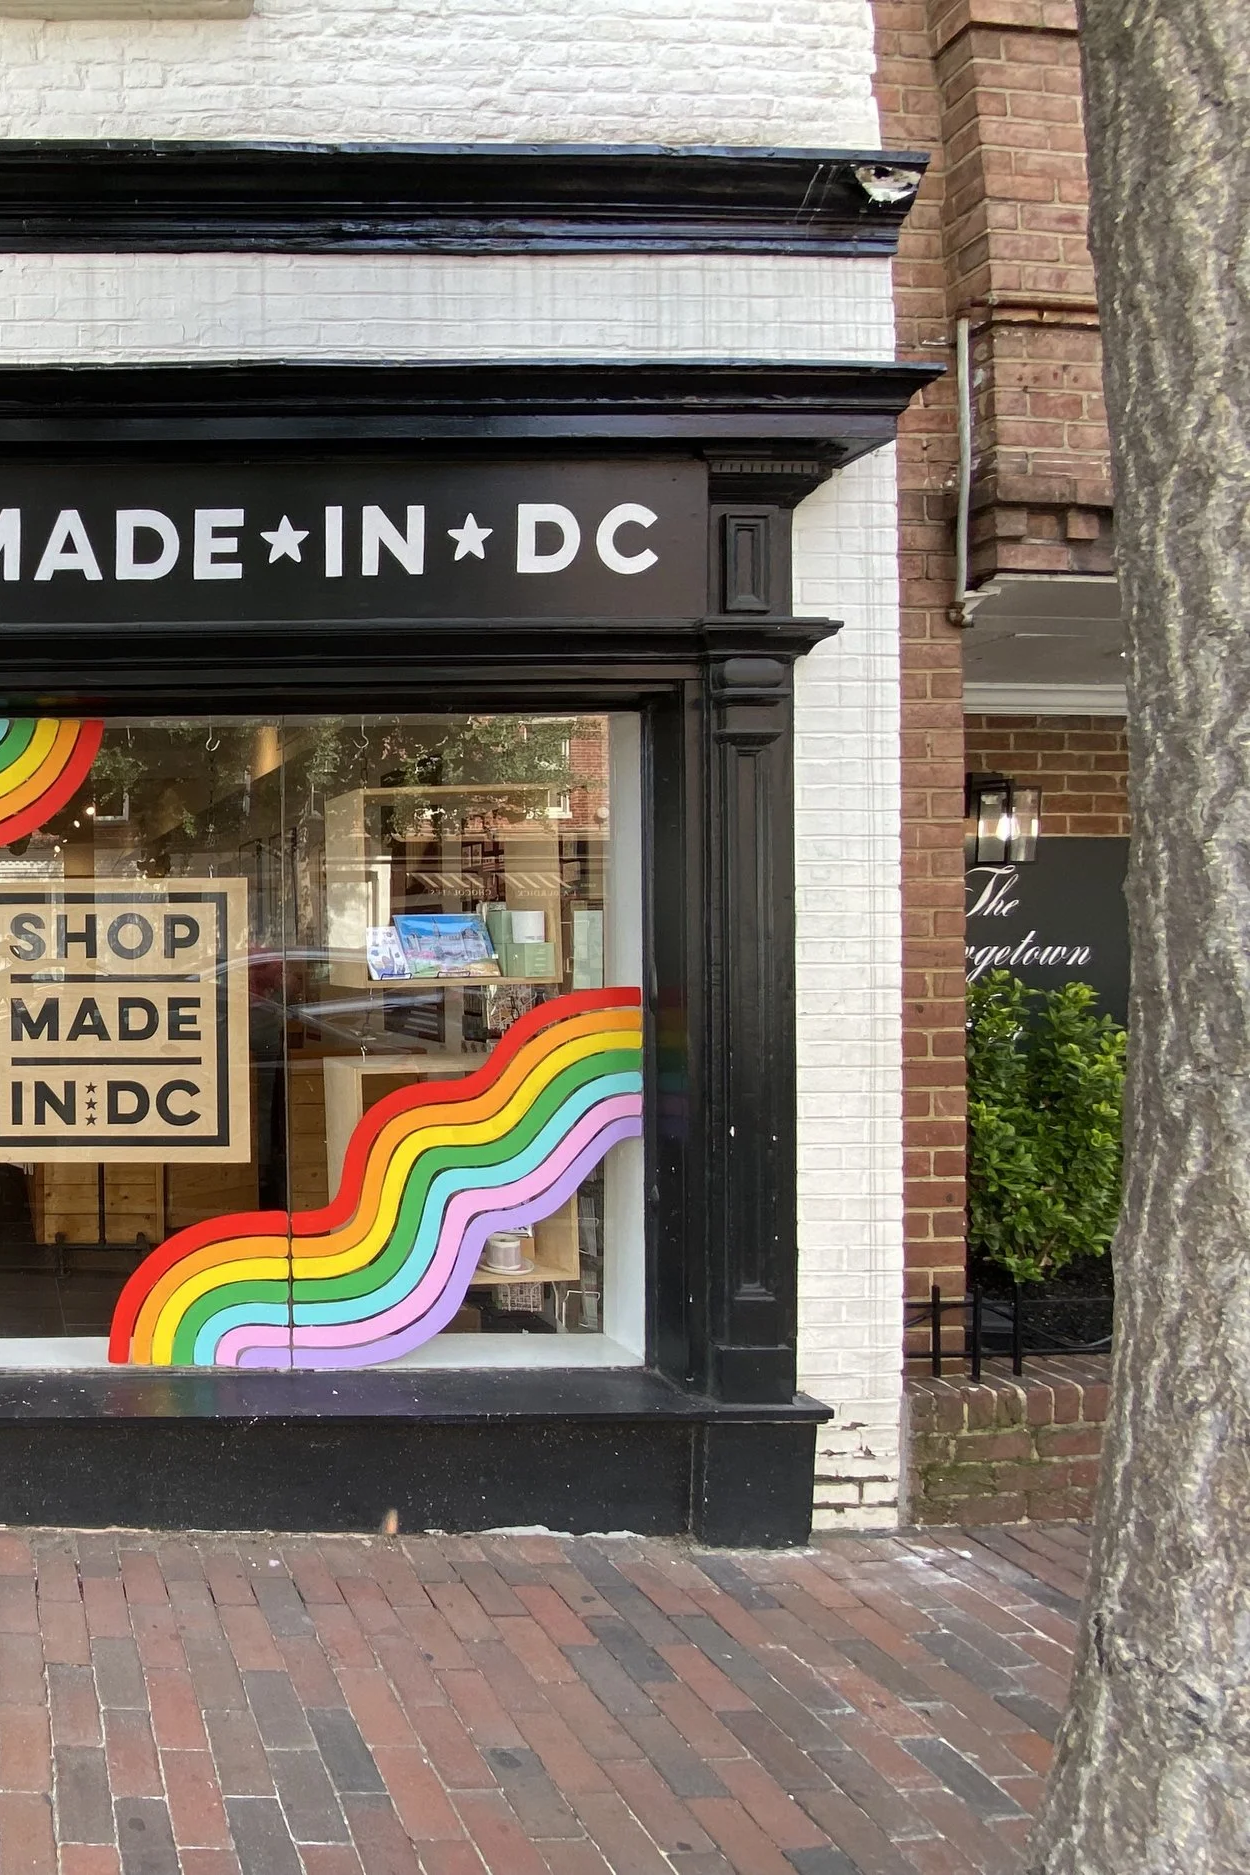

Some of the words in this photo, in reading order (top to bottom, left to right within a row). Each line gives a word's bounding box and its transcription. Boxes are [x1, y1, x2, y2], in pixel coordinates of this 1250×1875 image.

[325, 505, 425, 578] IN
[516, 502, 659, 575] DC
[965, 864, 1020, 918] The
[9, 912, 200, 960] SHOP
[10, 996, 202, 1042] MADE
[11, 1080, 78, 1127] IN
[106, 1078, 203, 1127] DC
